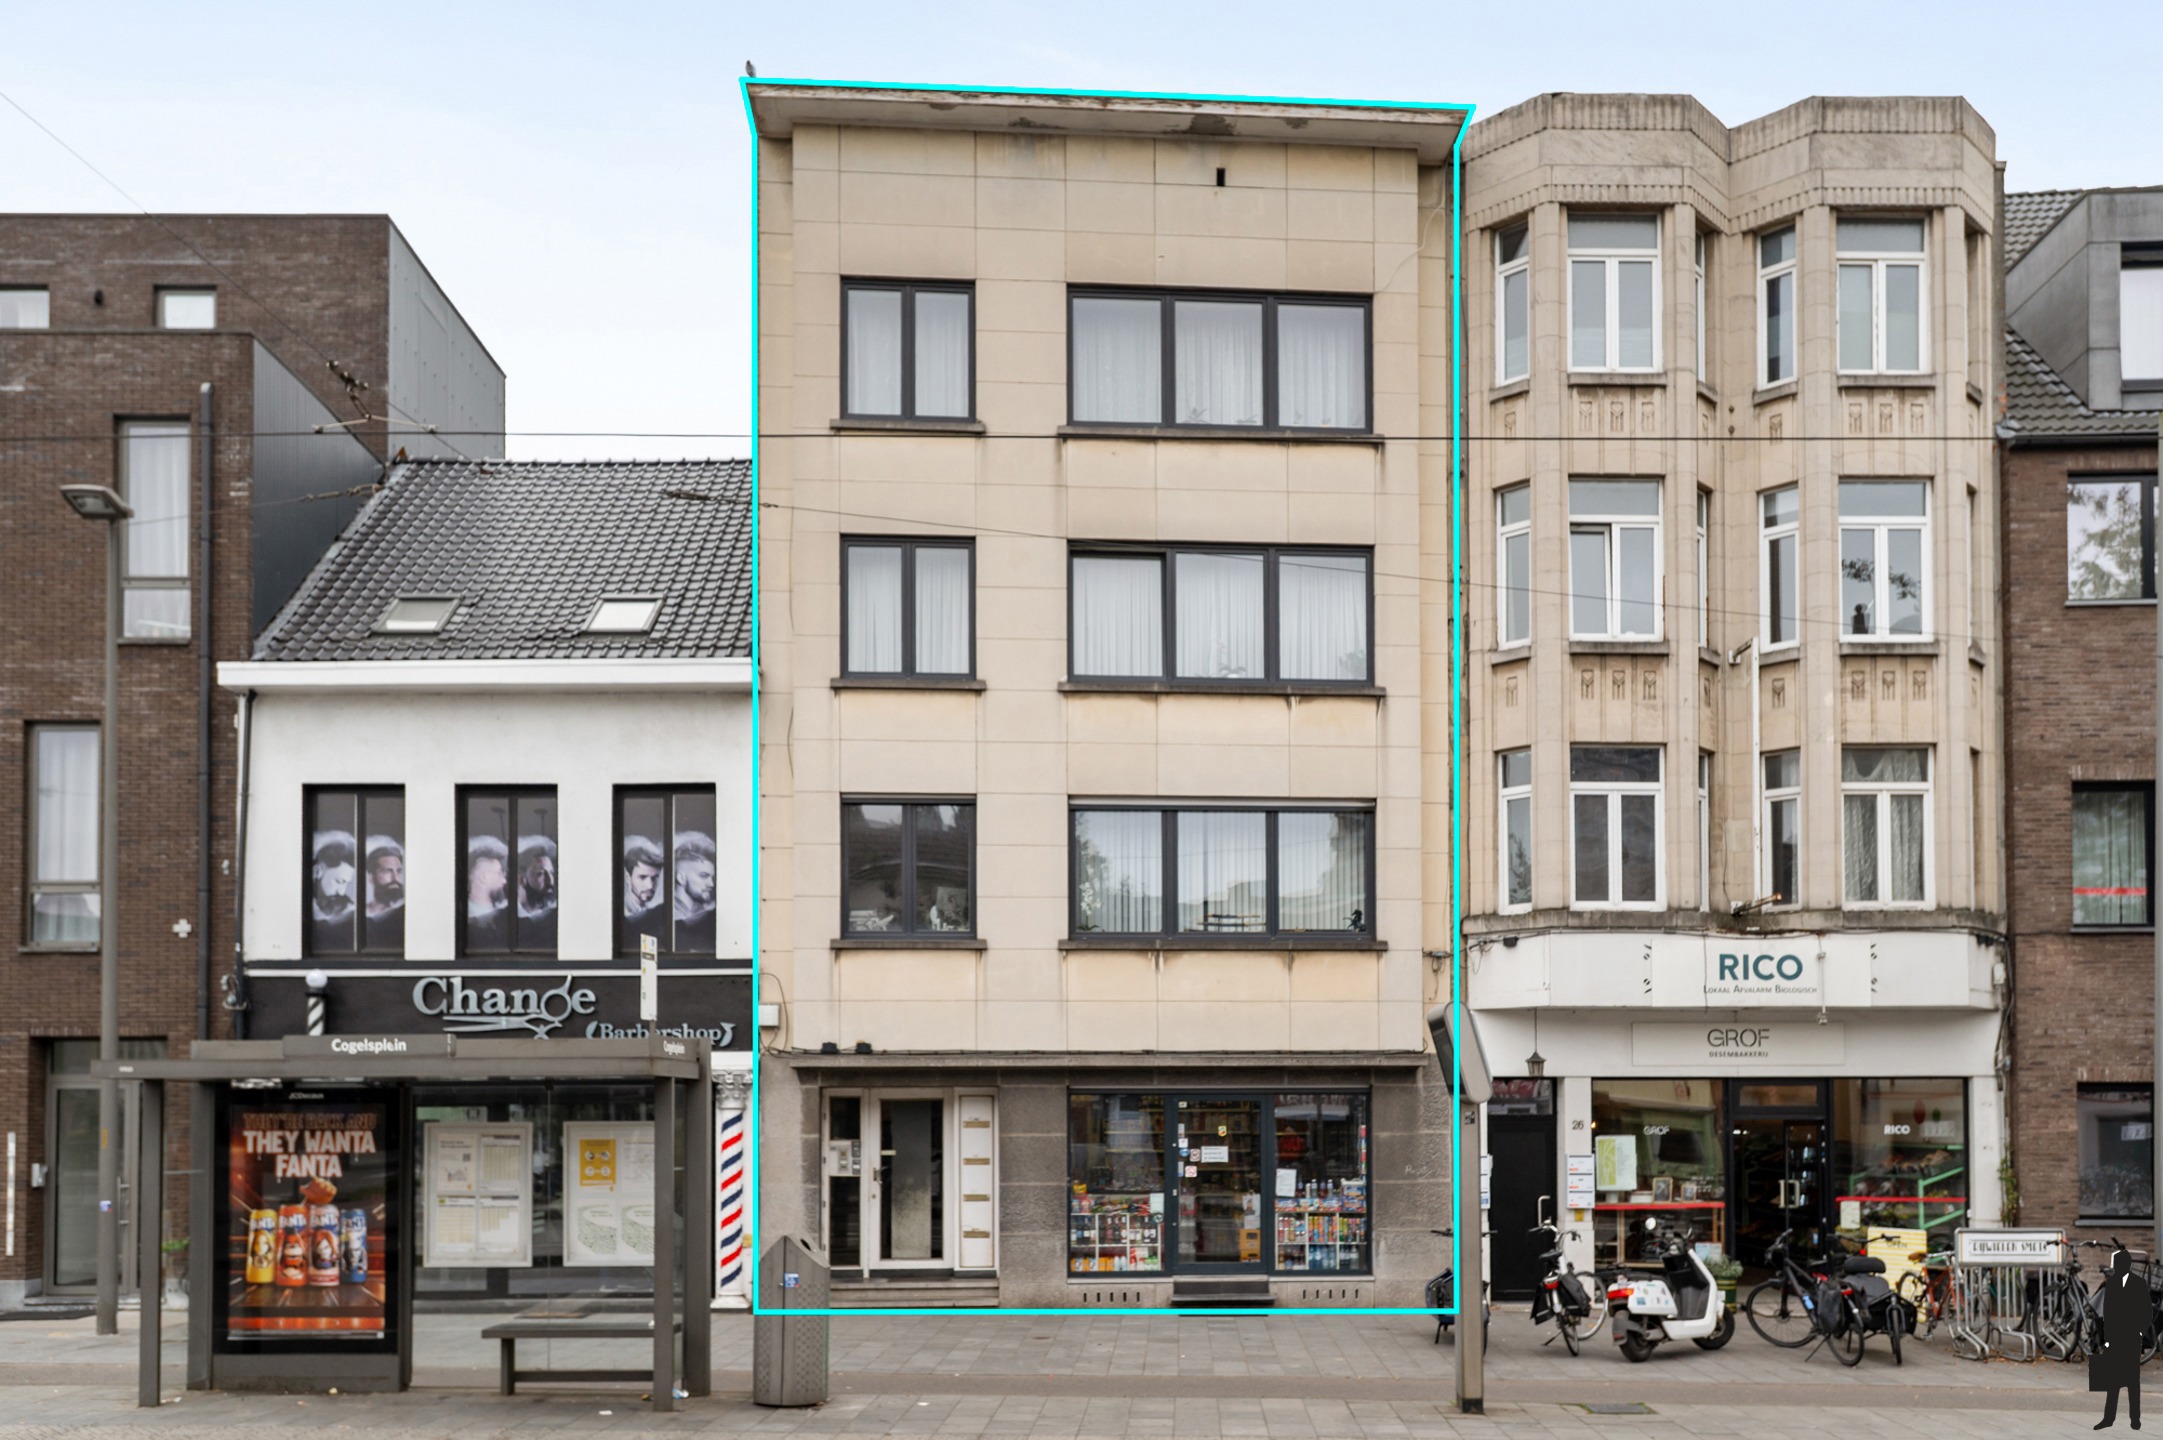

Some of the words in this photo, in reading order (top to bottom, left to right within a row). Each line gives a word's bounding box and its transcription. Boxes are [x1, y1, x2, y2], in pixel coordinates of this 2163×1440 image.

[1719, 953, 1803, 981] RICO
[600, 1022, 722, 1044] Barbrshop
[1707, 1028, 1770, 1048] GROF
[331, 1038, 407, 1055] Cogelsplein
[1572, 1120, 1585, 1130] 26
[1884, 1125, 1911, 1135] RICO
[243, 1130, 299, 1153] THEY
[304, 1130, 376, 1153] WANTA
[275, 1155, 342, 1178] FANTA
